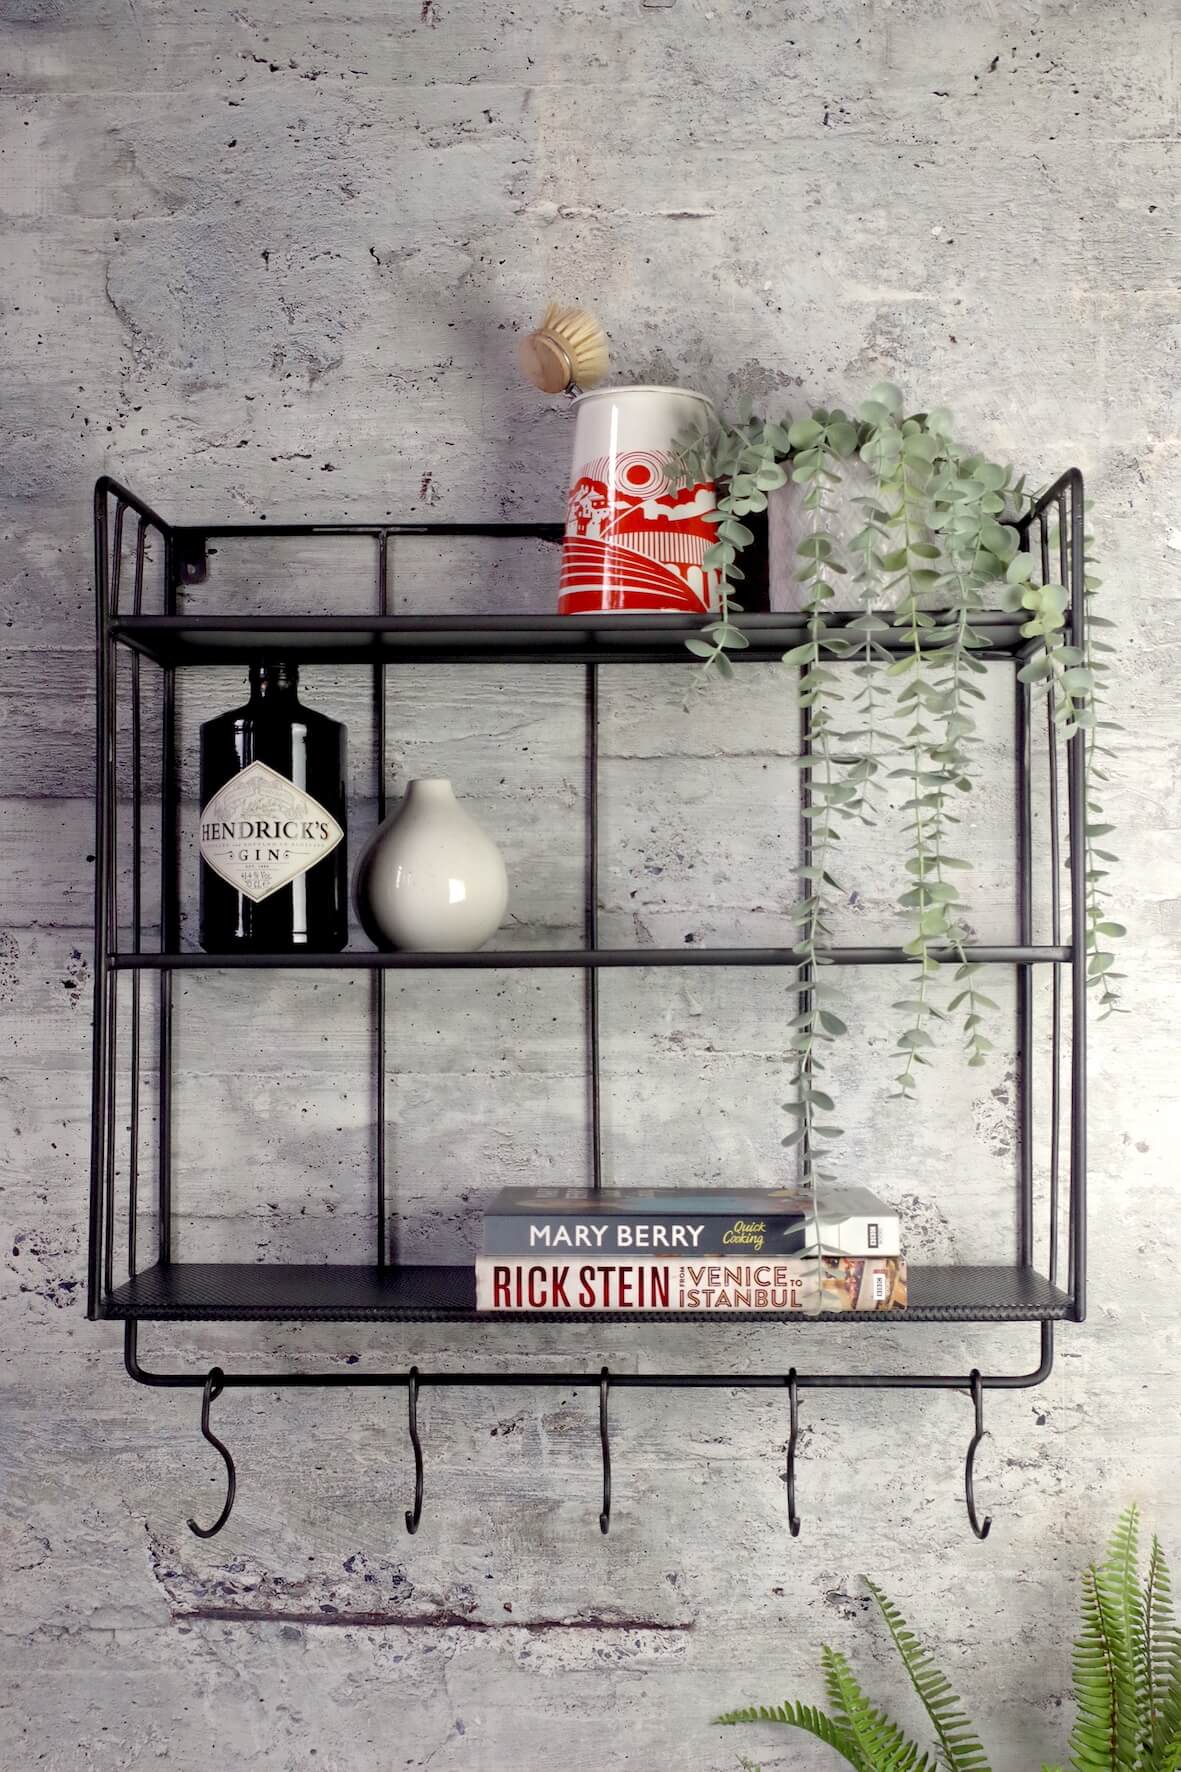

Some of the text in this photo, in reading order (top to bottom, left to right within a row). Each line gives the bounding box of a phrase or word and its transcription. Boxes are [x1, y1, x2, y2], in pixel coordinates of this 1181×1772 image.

[202, 820, 330, 841] HENDRICK'S
[238, 849, 280, 861] GIN
[529, 1224, 705, 1247] MARY BERRY
[733, 1220, 767, 1232] Quick
[722, 1230, 765, 1250] Cooking
[687, 1265, 803, 1287] VENICE TO
[493, 1265, 670, 1308] RICK STEIN
[679, 1288, 803, 1308] ISTANBUL
